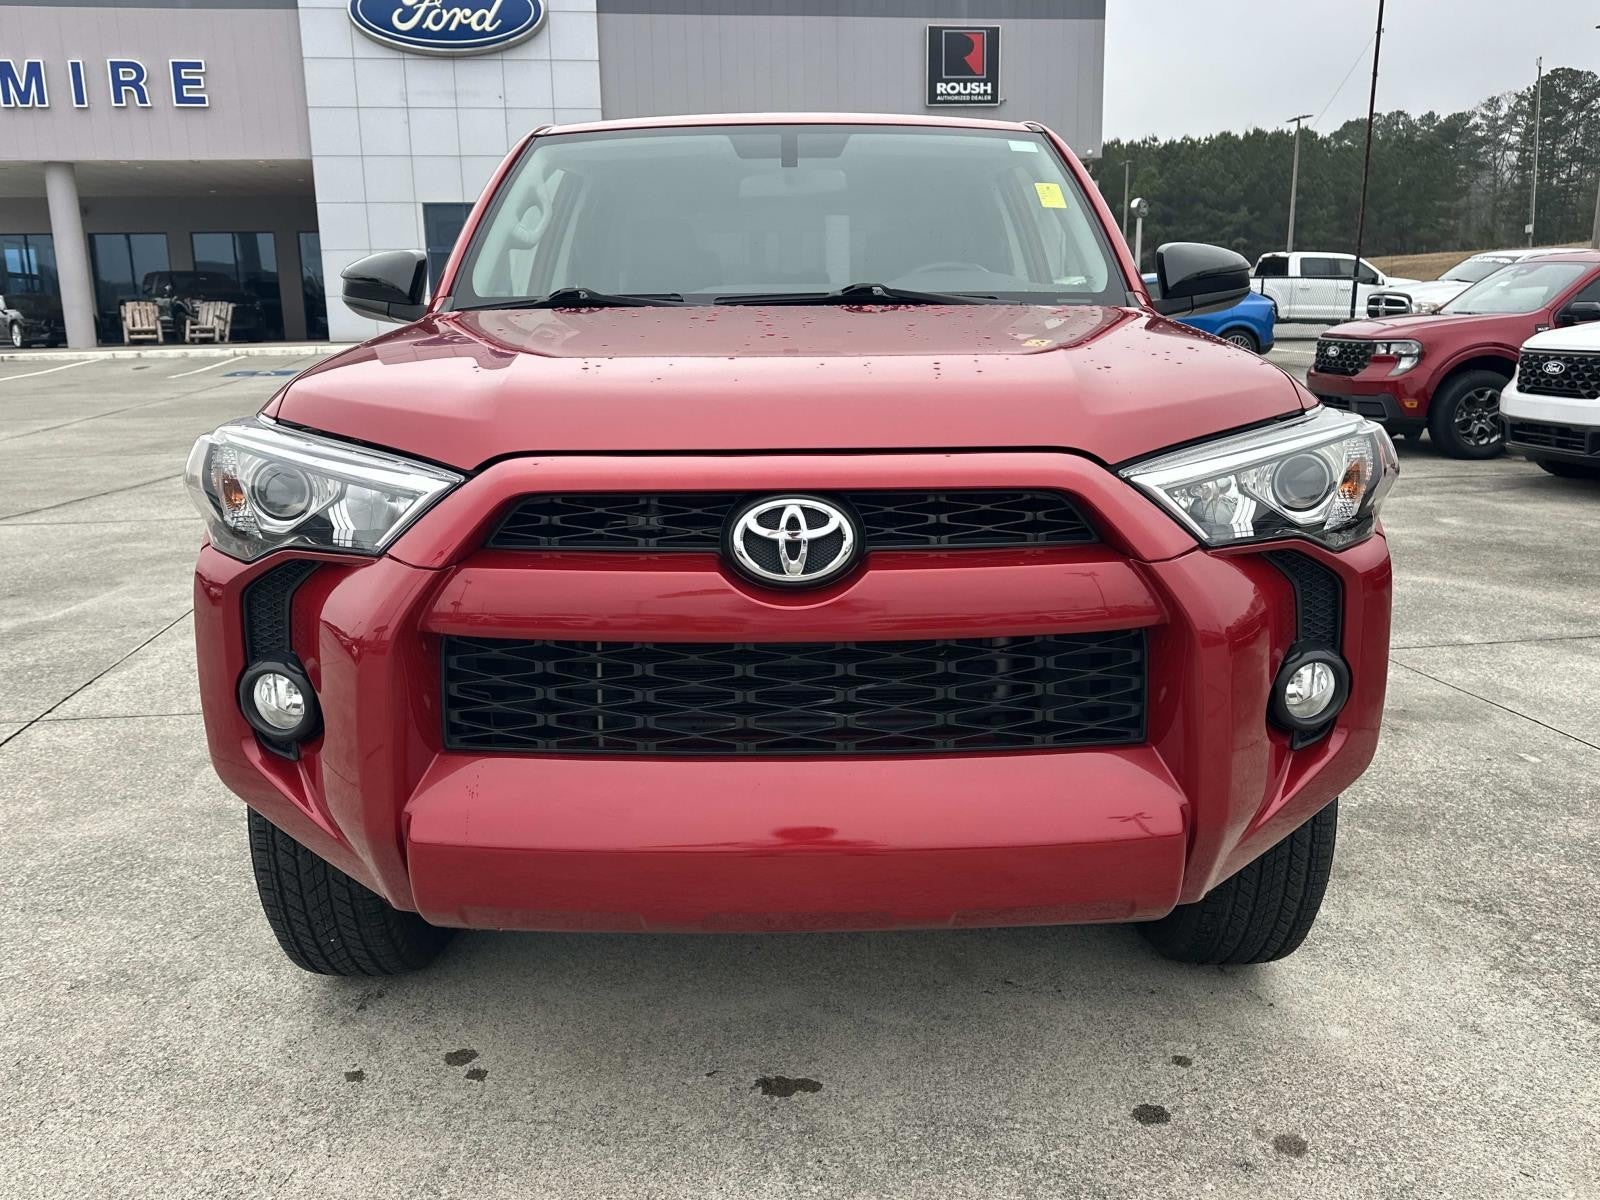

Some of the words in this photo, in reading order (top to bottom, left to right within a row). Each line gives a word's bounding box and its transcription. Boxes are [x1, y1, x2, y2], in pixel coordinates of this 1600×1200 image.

[392, 0, 502, 32] Ford
[0, 59, 209, 108] MIRE
[936, 82, 992, 95] ROUSH
